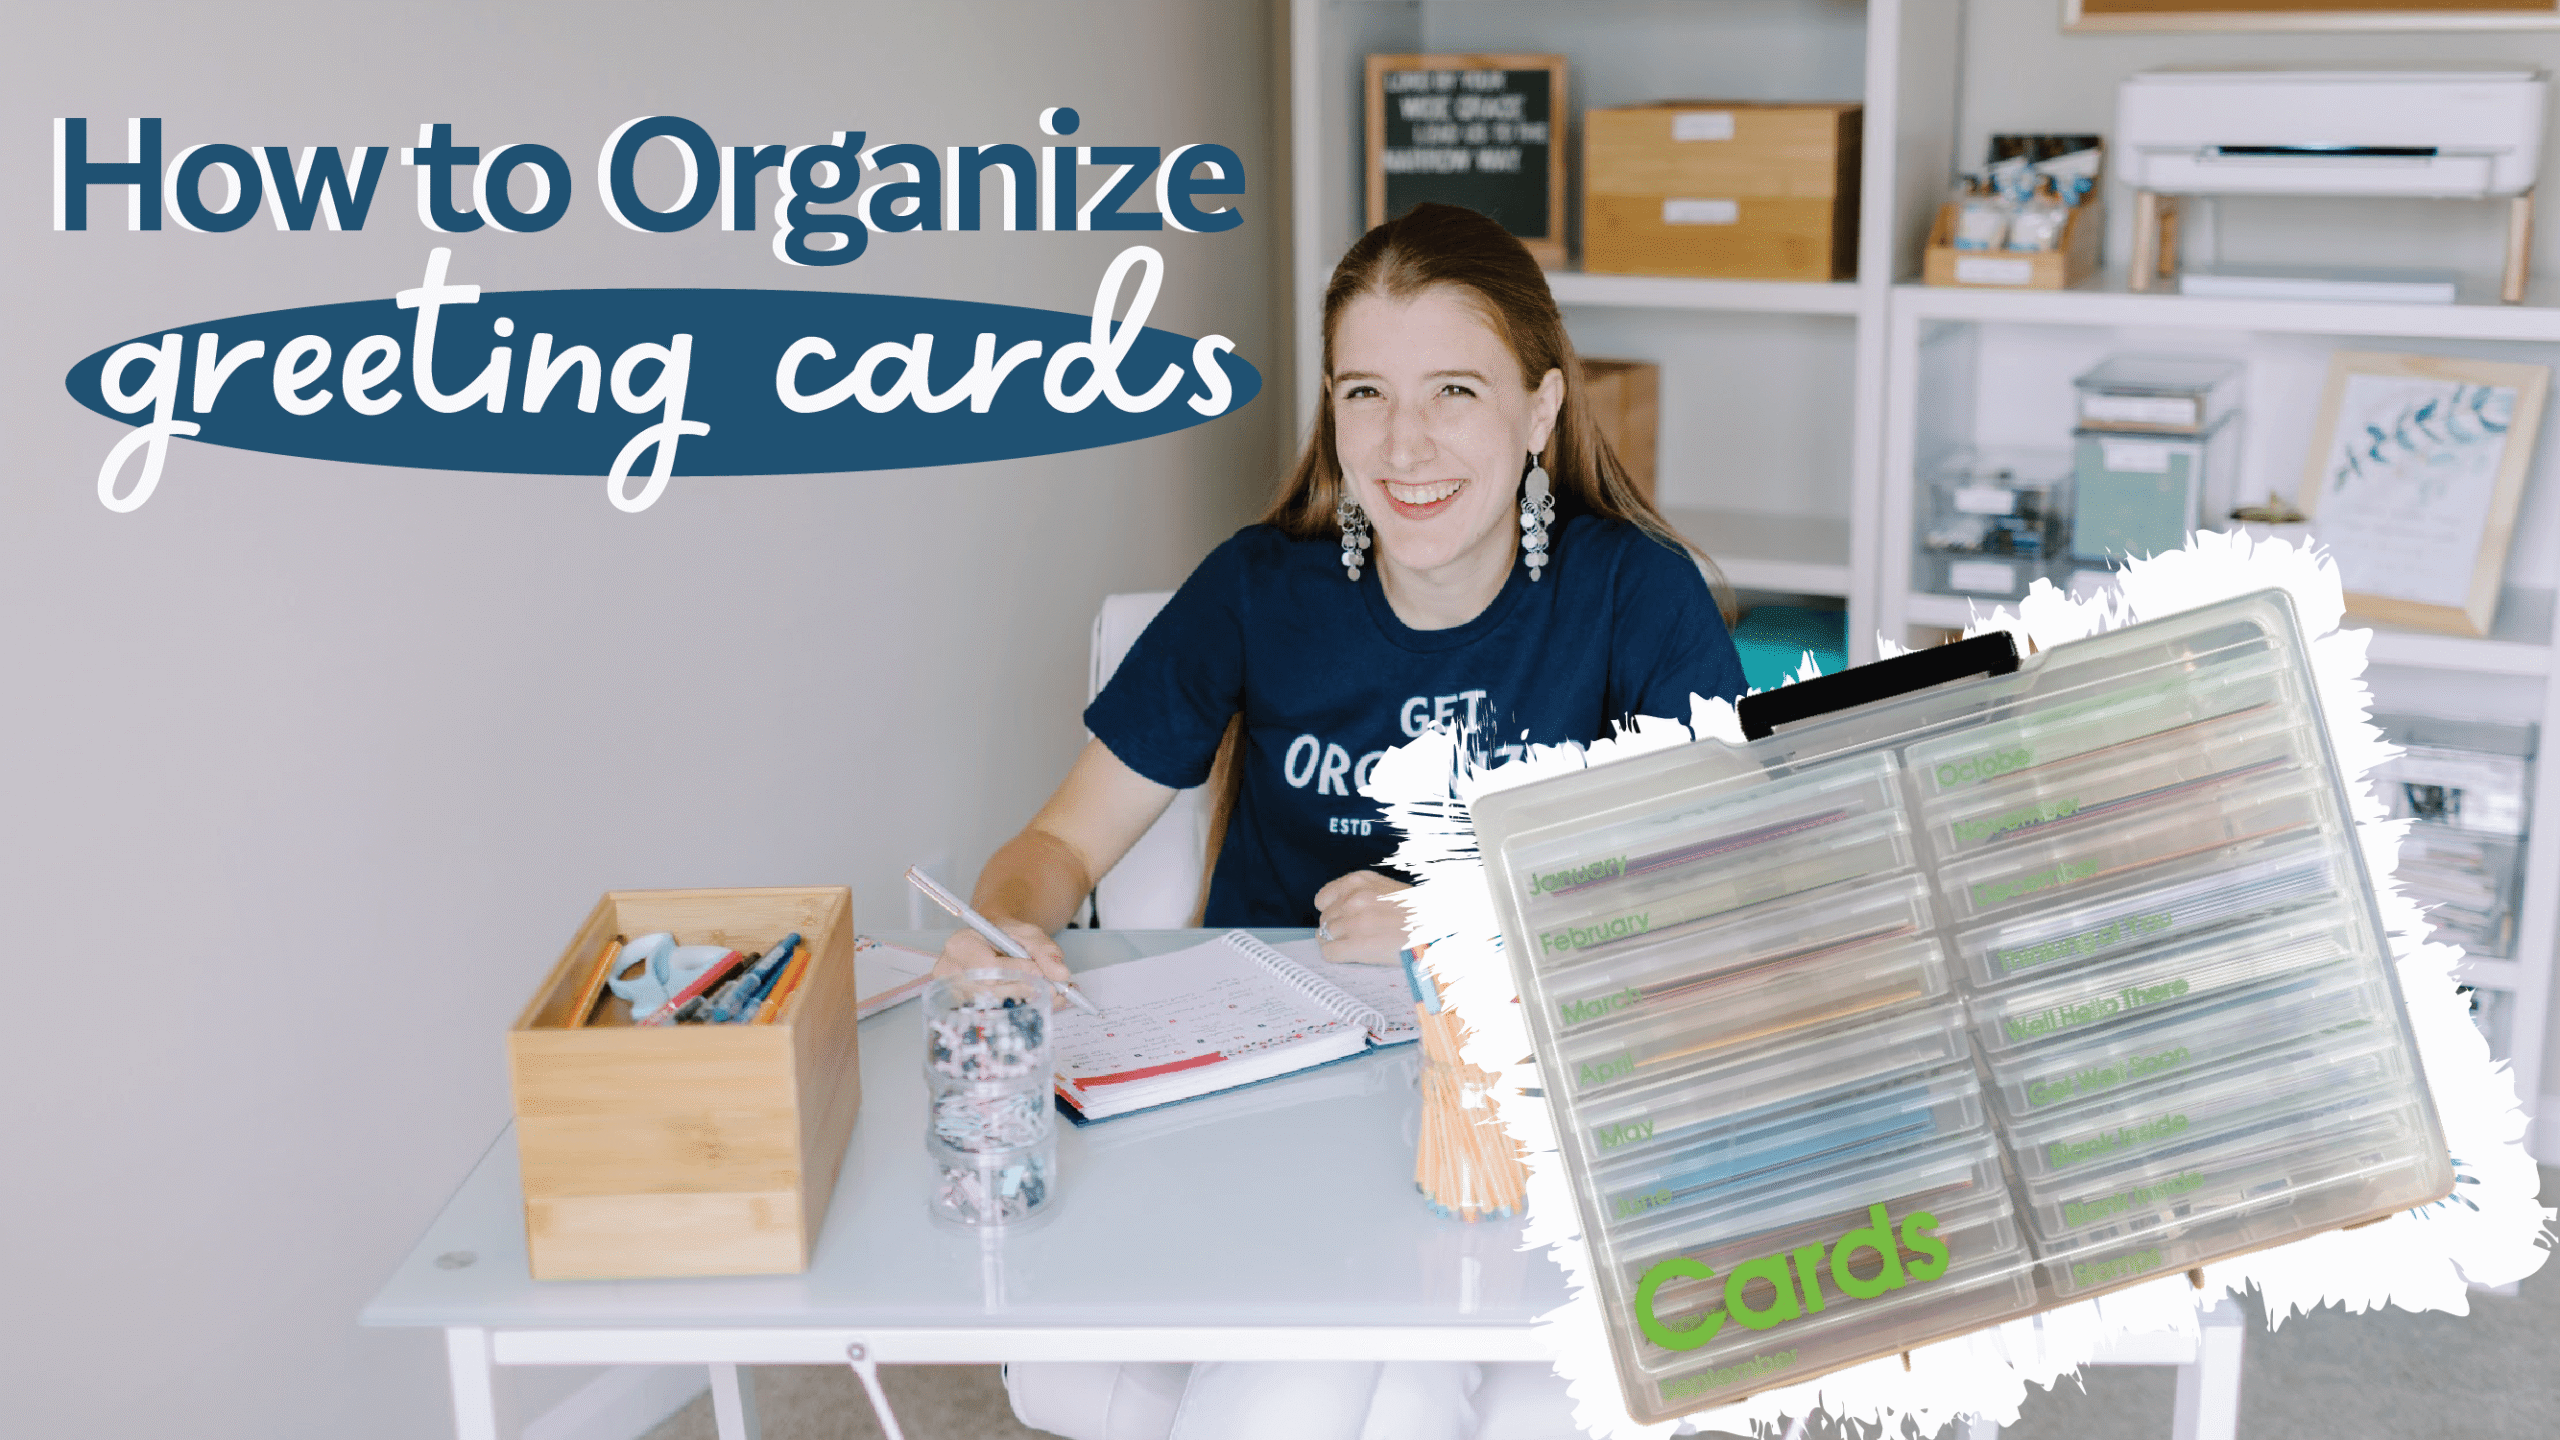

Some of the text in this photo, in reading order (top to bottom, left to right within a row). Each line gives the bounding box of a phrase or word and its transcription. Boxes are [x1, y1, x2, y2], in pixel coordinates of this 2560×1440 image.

[1400, 690, 1487, 738] GET
[1329, 817, 1372, 836] ESTD
[1952, 796, 2080, 843] November
[1529, 855, 1627, 896] January
[1972, 858, 2099, 907] December
[1539, 912, 1649, 955] February
[1561, 987, 1642, 1025] March
[2059, 998, 2119, 1029] Hello
[2119, 978, 2190, 1009] There
[1579, 1051, 1635, 1087] April
[2075, 1059, 2128, 1092] Well
[2129, 1046, 2191, 1078] Soon
[1599, 1119, 1654, 1150] May
[2118, 1113, 2190, 1149] Inside
[1613, 1188, 1673, 1220] June
[1634, 1202, 1950, 1352] Cards
[1660, 1349, 1798, 1401] September
